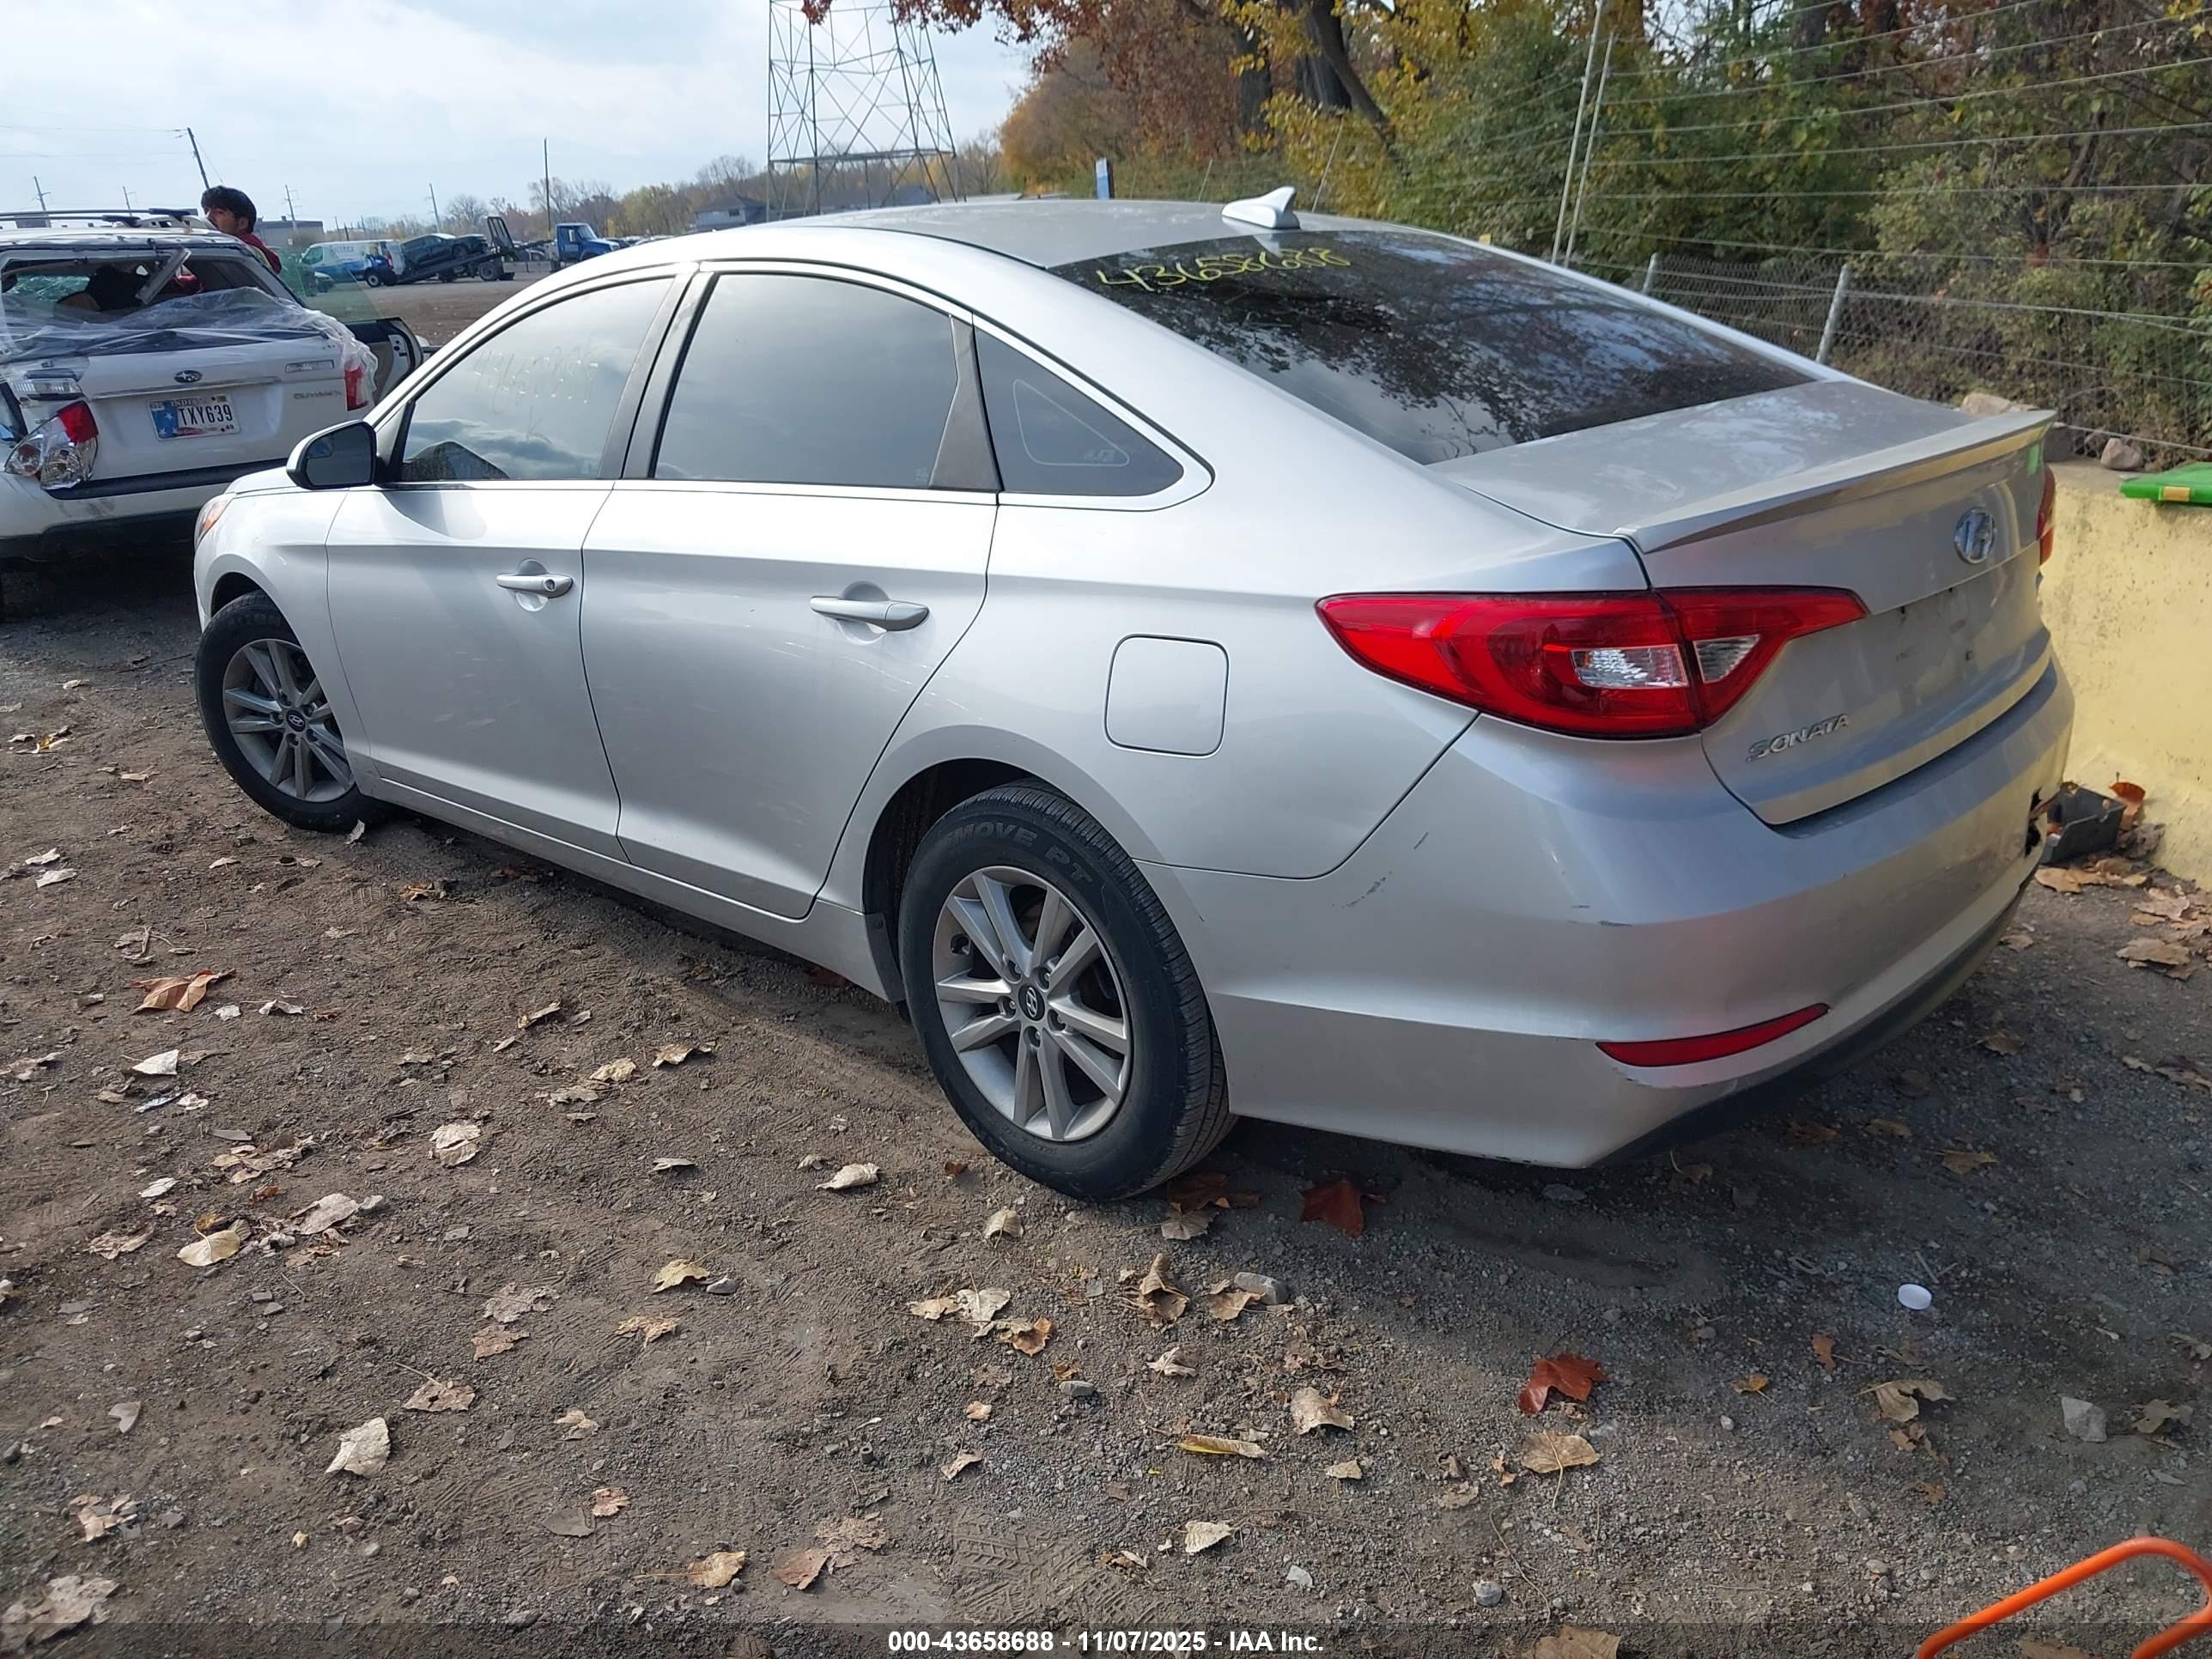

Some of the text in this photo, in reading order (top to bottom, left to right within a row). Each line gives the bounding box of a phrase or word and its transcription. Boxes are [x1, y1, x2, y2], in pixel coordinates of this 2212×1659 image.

[1096, 246, 1352, 293] 43658688
[178, 404, 234, 426] TXY639
[1746, 713, 1850, 763] SONATA
[1044, 844, 1094, 884] PT
